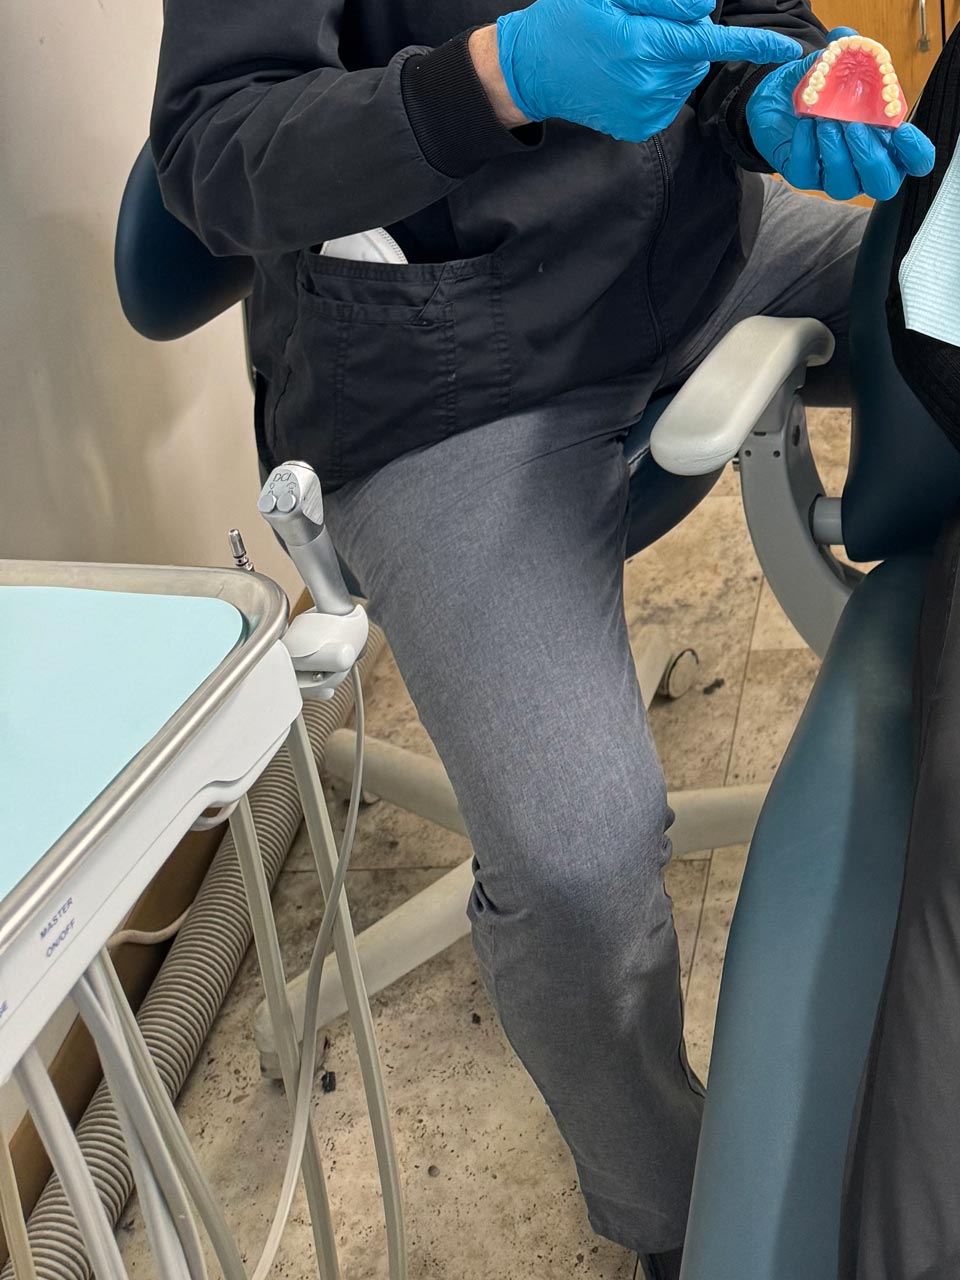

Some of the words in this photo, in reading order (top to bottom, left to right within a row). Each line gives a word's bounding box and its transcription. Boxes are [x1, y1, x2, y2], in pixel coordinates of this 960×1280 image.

[273, 473, 292, 482] DCI
[40, 897, 73, 939] MASTER
[46, 918, 76, 958] ON/OFF
